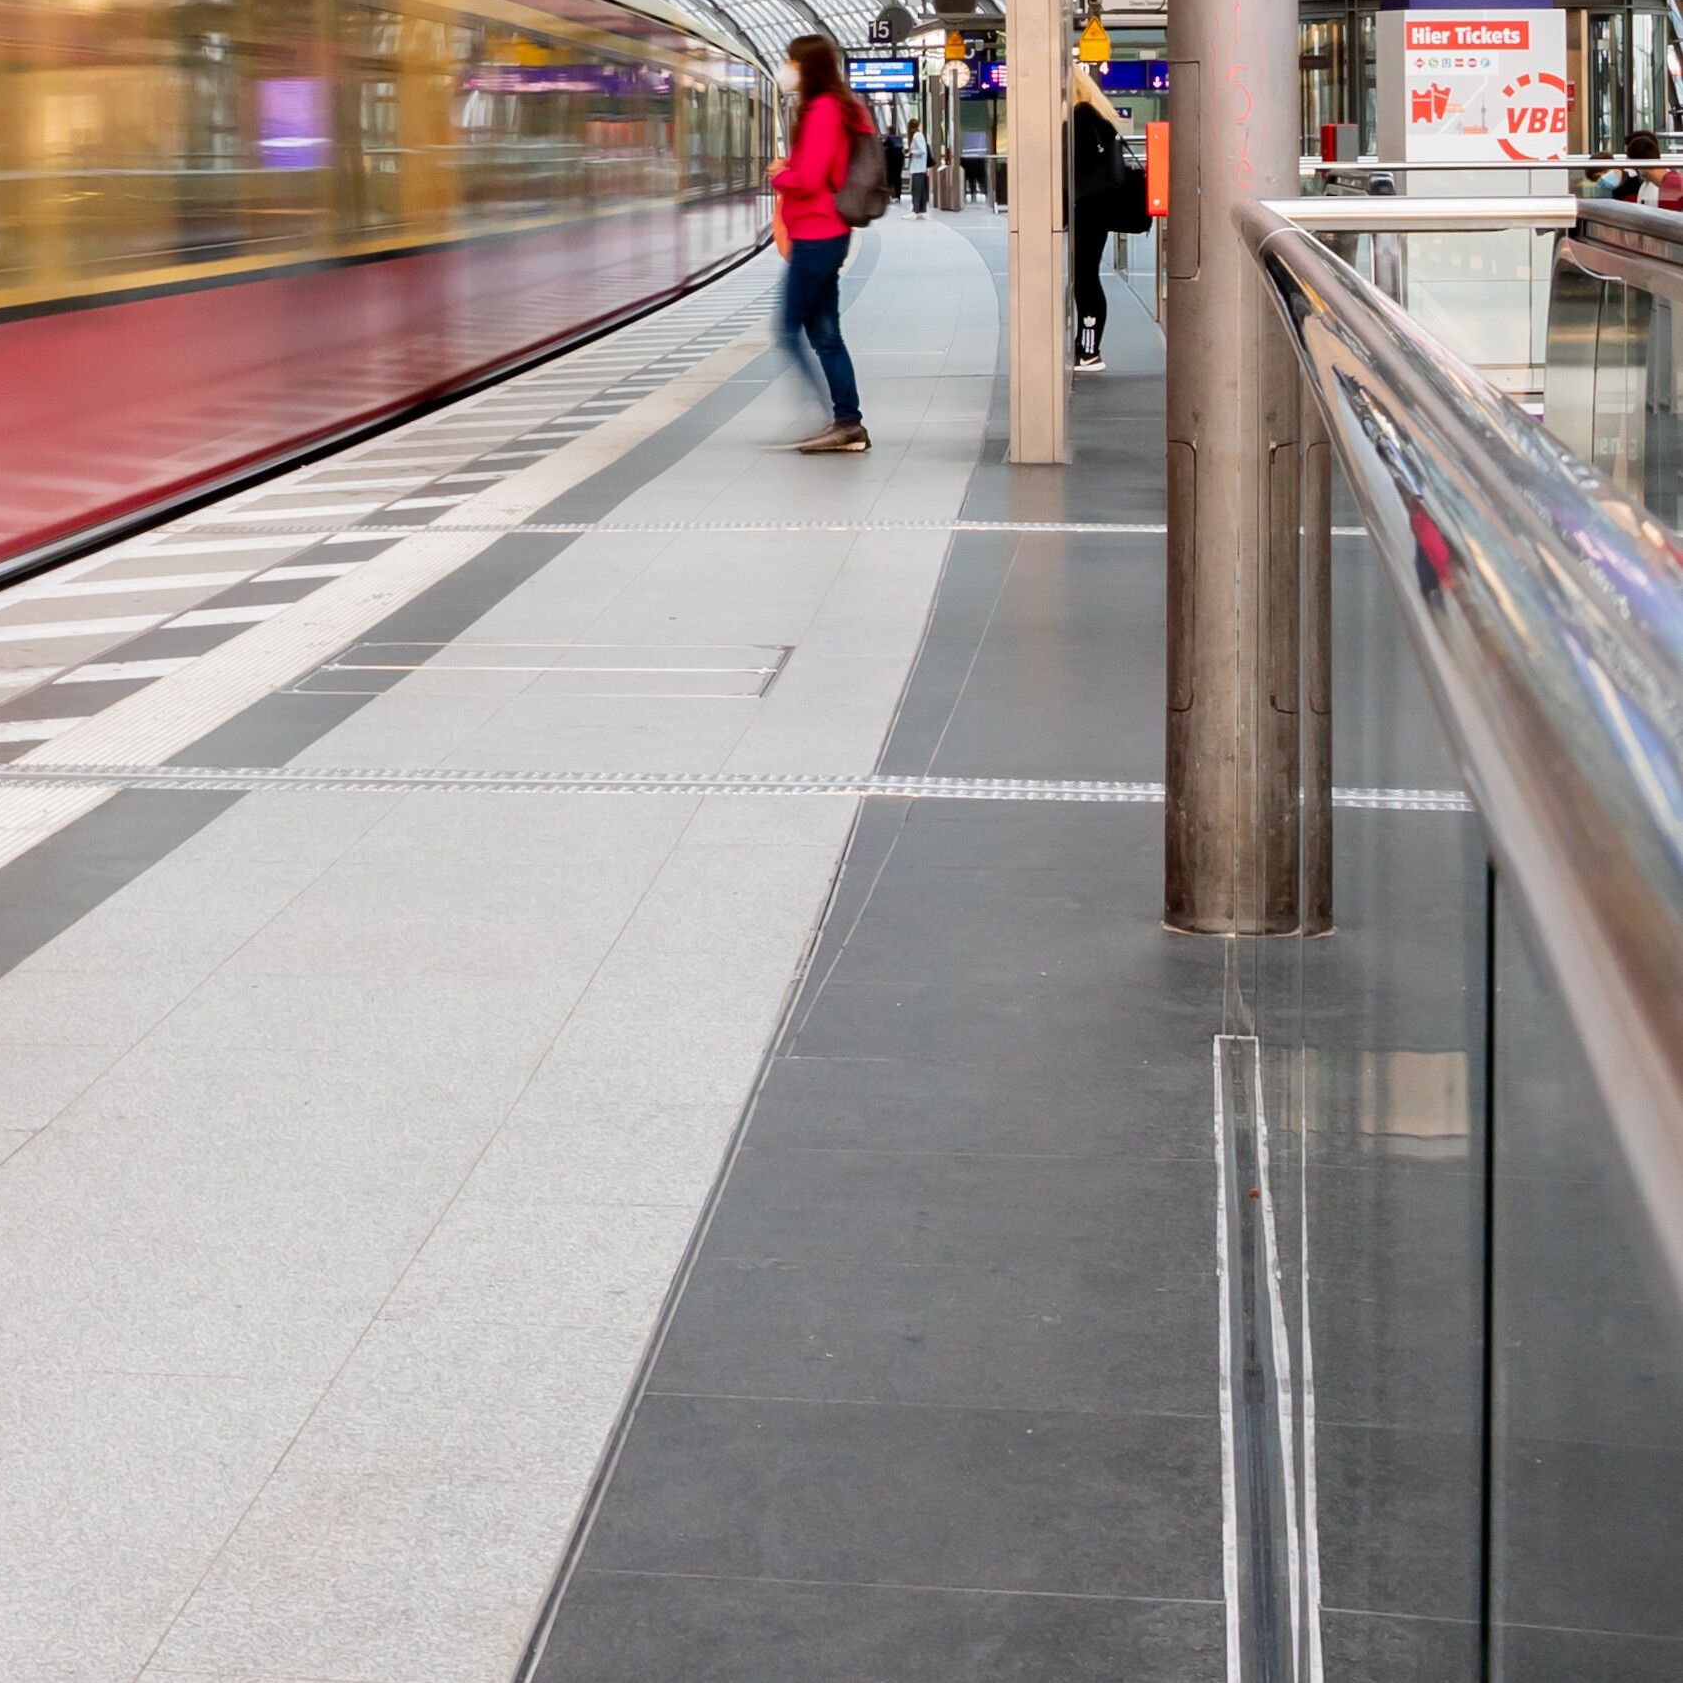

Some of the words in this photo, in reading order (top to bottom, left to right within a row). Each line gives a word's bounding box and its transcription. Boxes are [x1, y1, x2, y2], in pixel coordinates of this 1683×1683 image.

[869, 20, 890, 39] 15
[1411, 26, 1451, 45] Hier
[1454, 25, 1521, 45] Tickets
